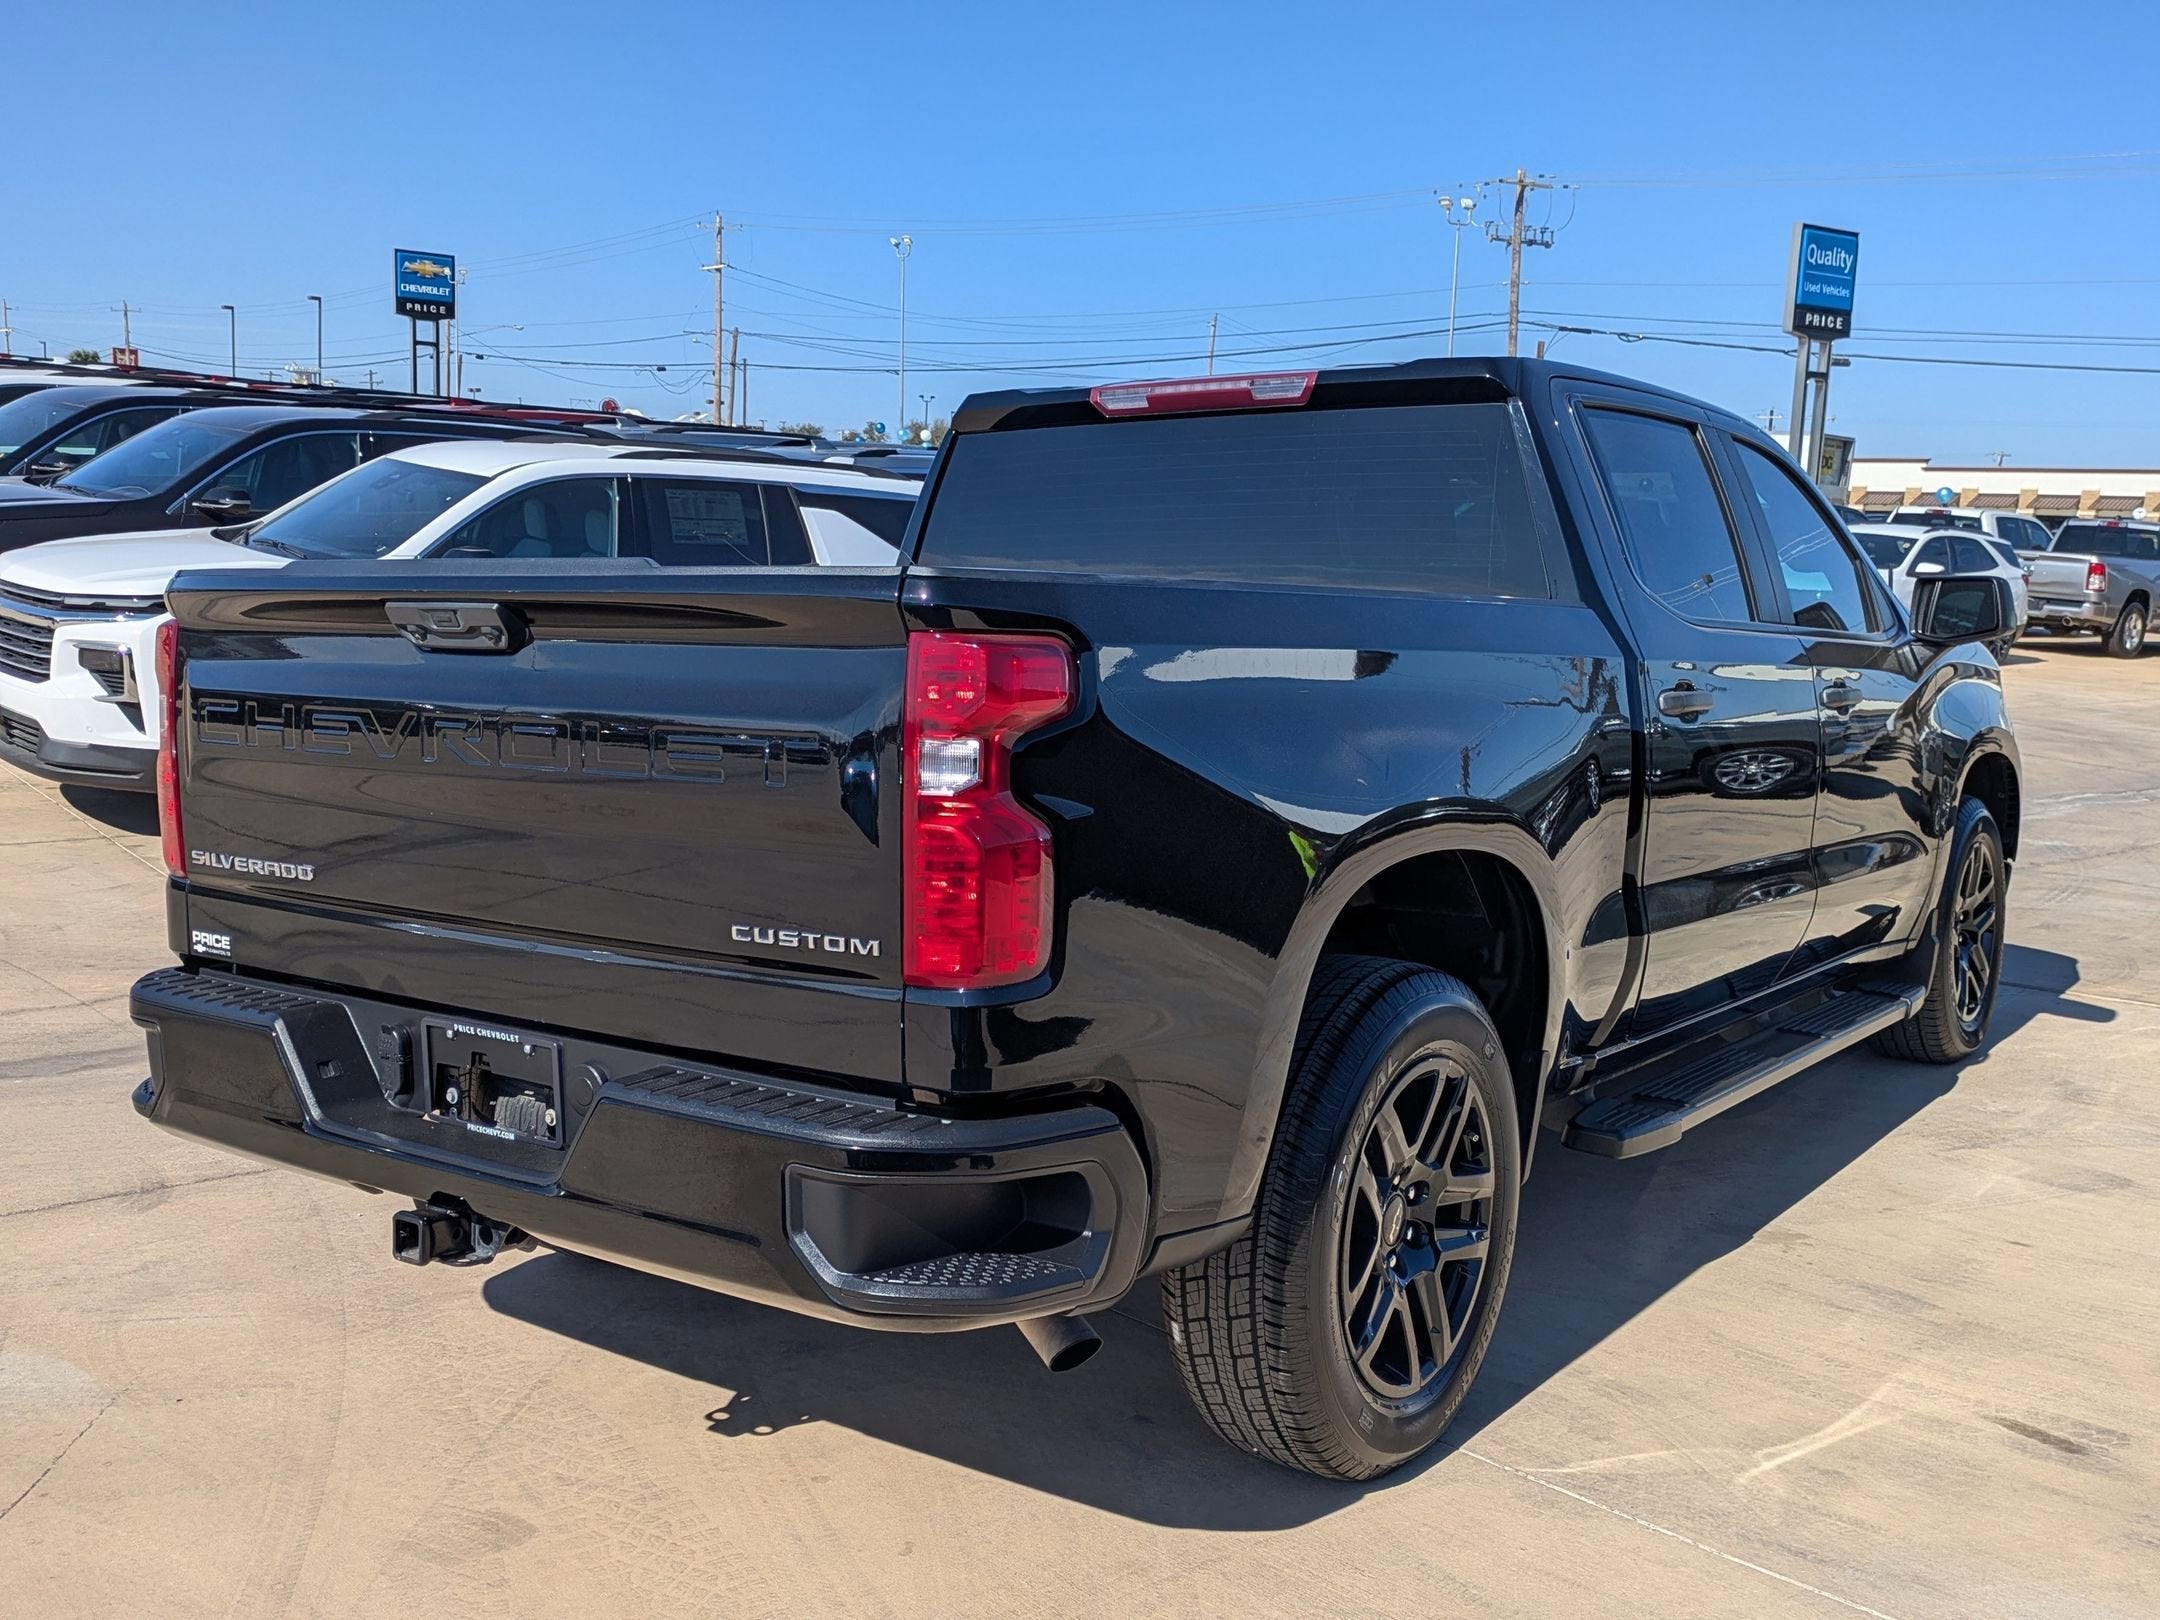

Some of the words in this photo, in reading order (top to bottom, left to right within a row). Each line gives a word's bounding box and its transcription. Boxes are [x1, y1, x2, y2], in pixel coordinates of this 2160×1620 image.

[1807, 243, 1853, 274] Quality
[400, 283, 451, 296] CHEVROLET
[1804, 281, 1821, 294] Used
[1822, 282, 1850, 298] Vehicles
[406, 302, 447, 314] PRICE
[1805, 313, 1844, 330] PRICE
[198, 699, 833, 789] CHEVROLET
[191, 849, 315, 881] SILVERADO
[192, 930, 231, 950] PRICE
[731, 923, 881, 957] CUSTOM
[453, 1023, 476, 1035] PRICE
[476, 1028, 520, 1043] CHEVROLET
[467, 1123, 515, 1141] PRICECHEVY.COM
[1329, 1054, 1400, 1234] GENERAL
[1460, 1219, 1516, 1394] GRABBER
